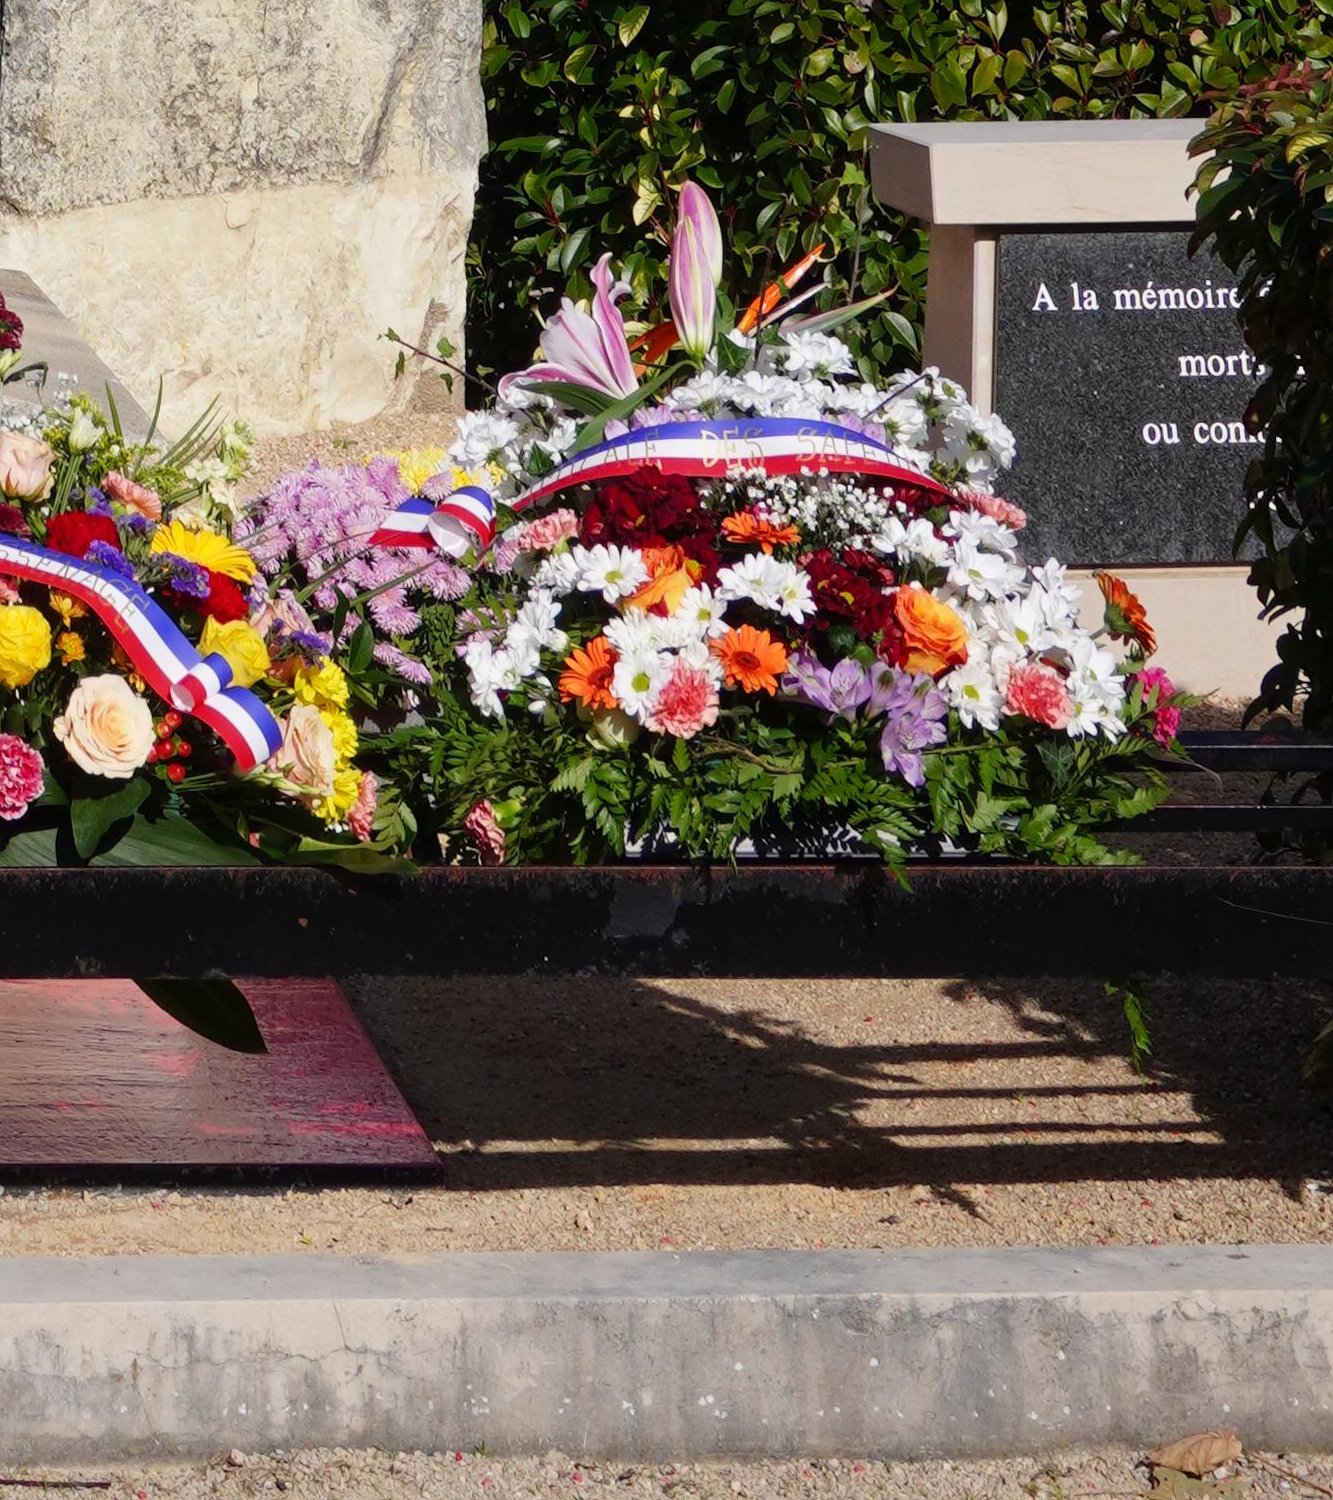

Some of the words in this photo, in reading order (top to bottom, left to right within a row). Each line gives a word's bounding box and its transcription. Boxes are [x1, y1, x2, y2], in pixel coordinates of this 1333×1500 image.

[1032, 282, 1058, 311] A
[1070, 282, 1100, 311] la
[1112, 280, 1244, 310] mémoire
[700, 426, 764, 469] DES
[1142, 422, 1180, 445] ou
